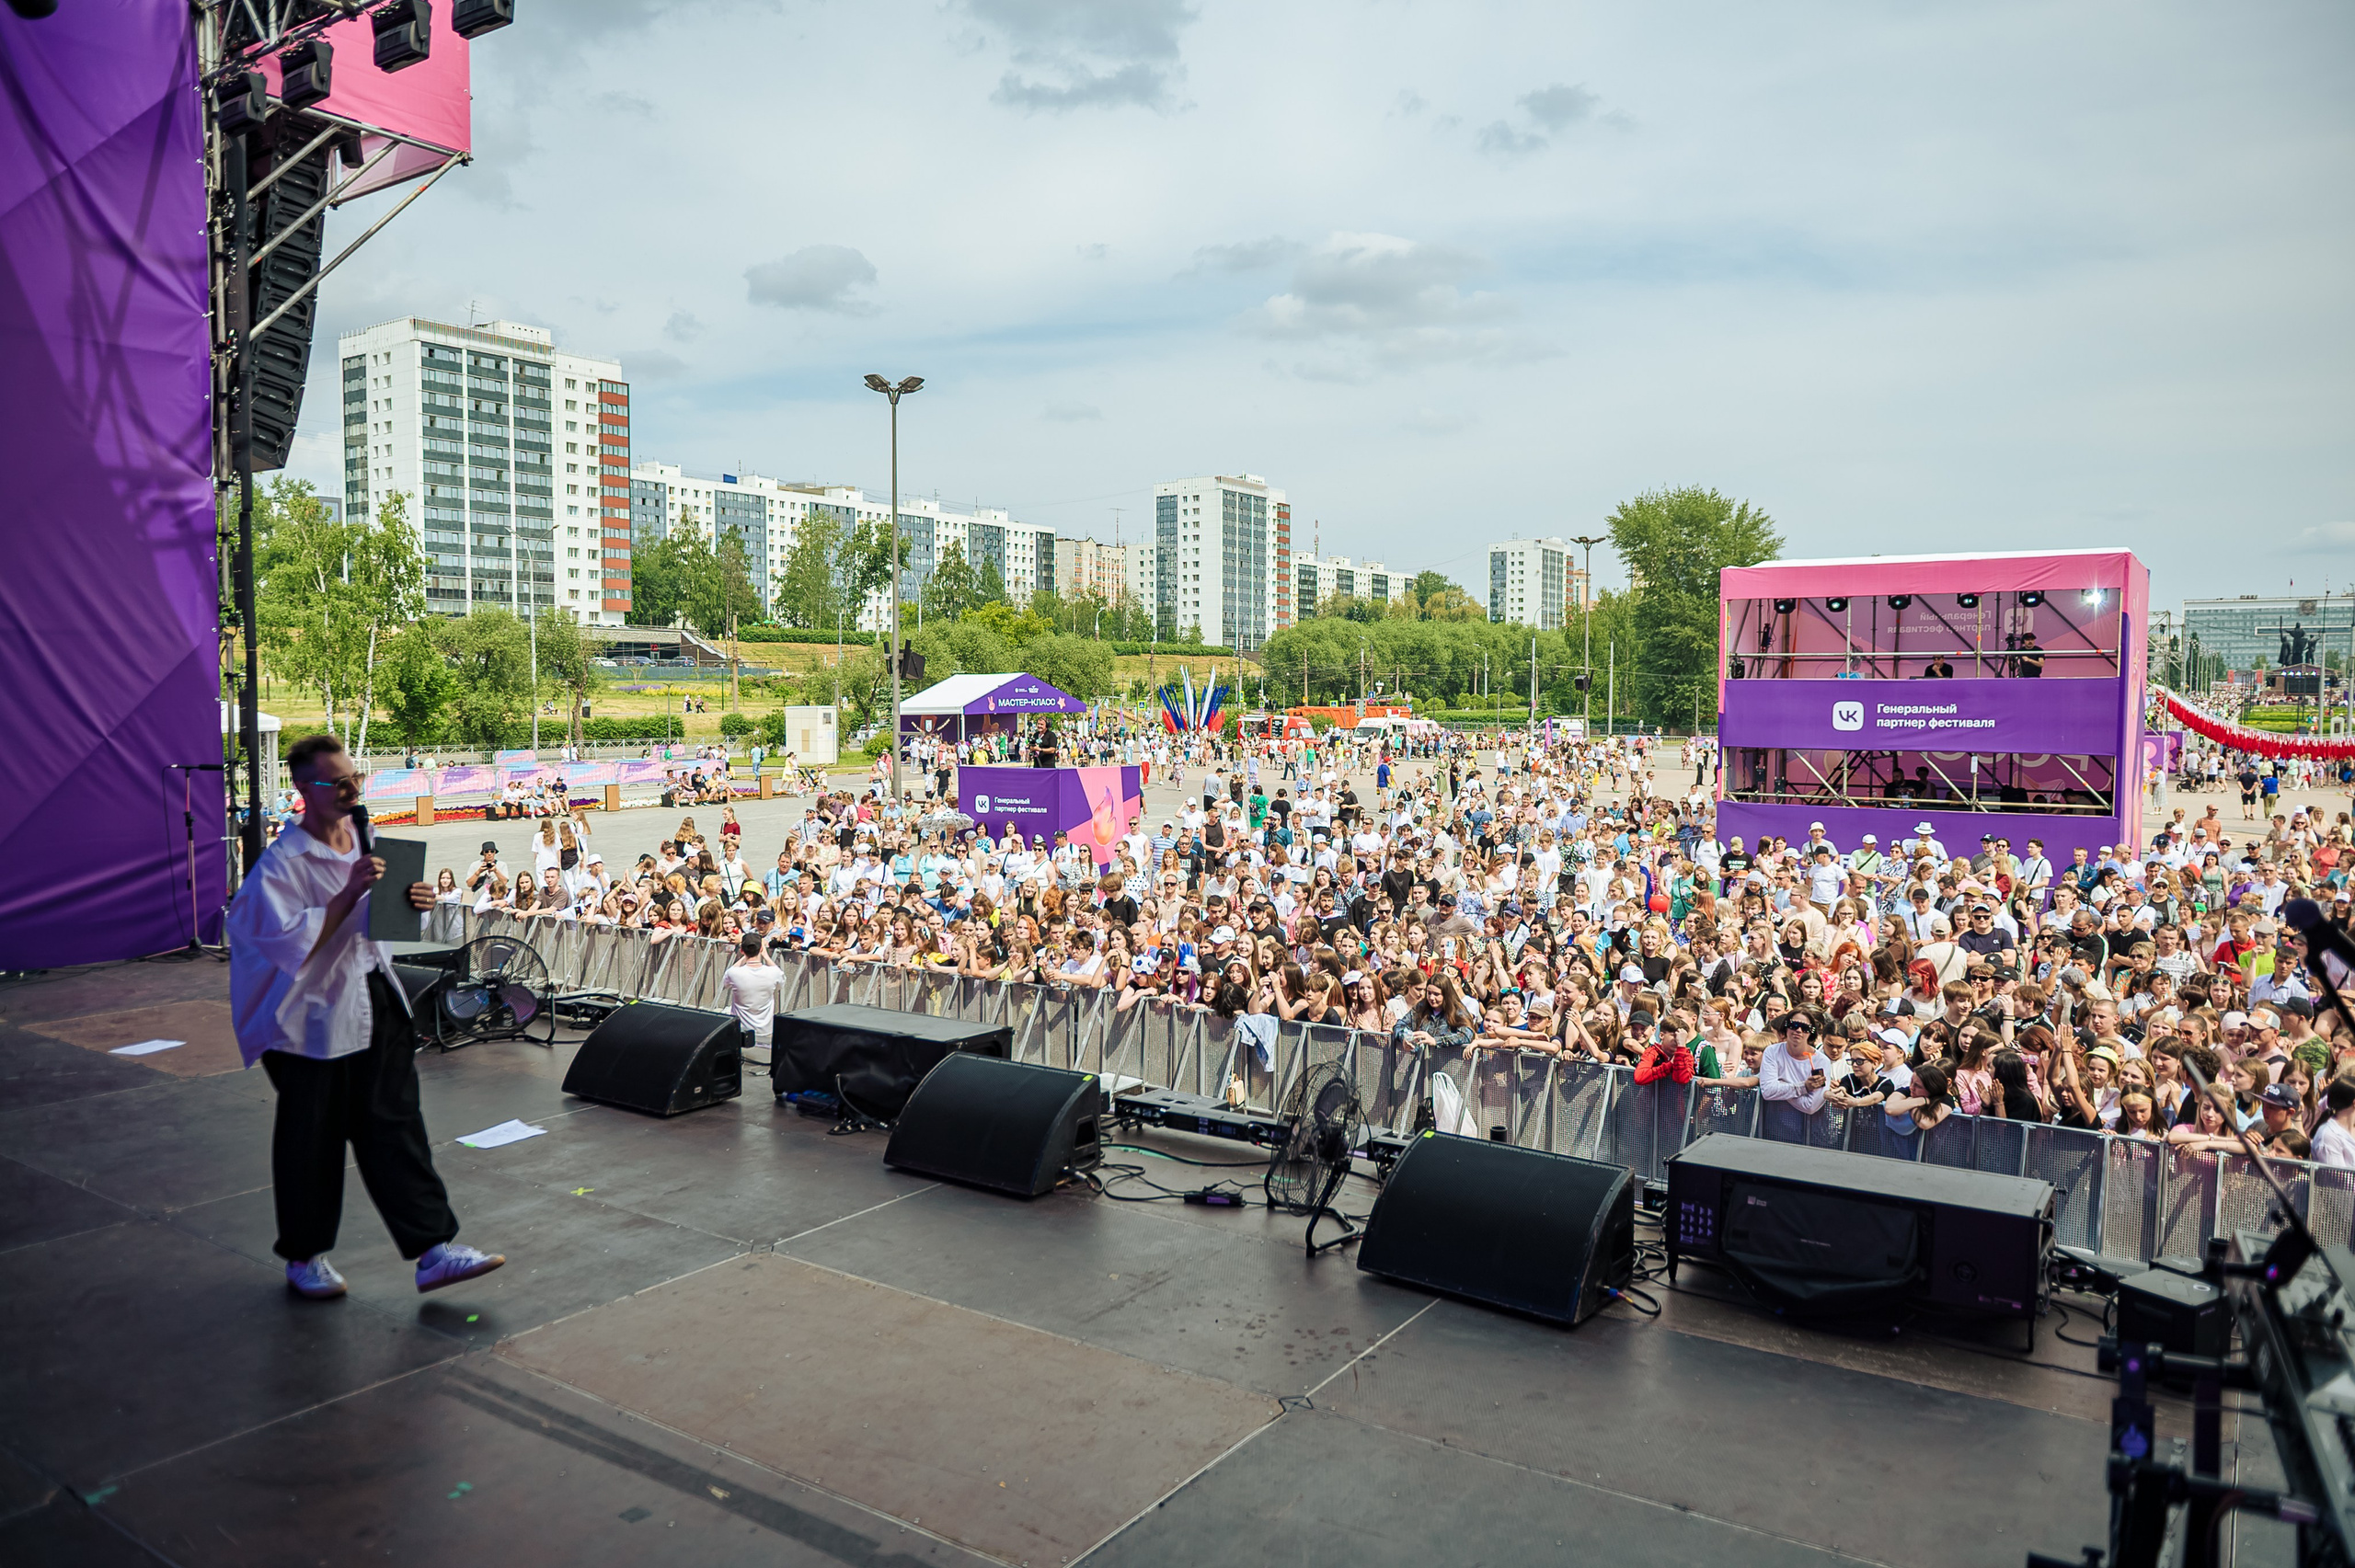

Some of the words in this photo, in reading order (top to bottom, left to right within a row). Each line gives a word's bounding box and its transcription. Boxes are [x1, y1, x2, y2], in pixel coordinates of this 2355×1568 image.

[1877, 704, 1958, 715] Генеральный
[1877, 718, 1926, 729] партнер
[1928, 717, 1995, 729] фестиваля
[994, 796, 1030, 805] Генеральный
[1017, 806, 1048, 814] фестиваля
